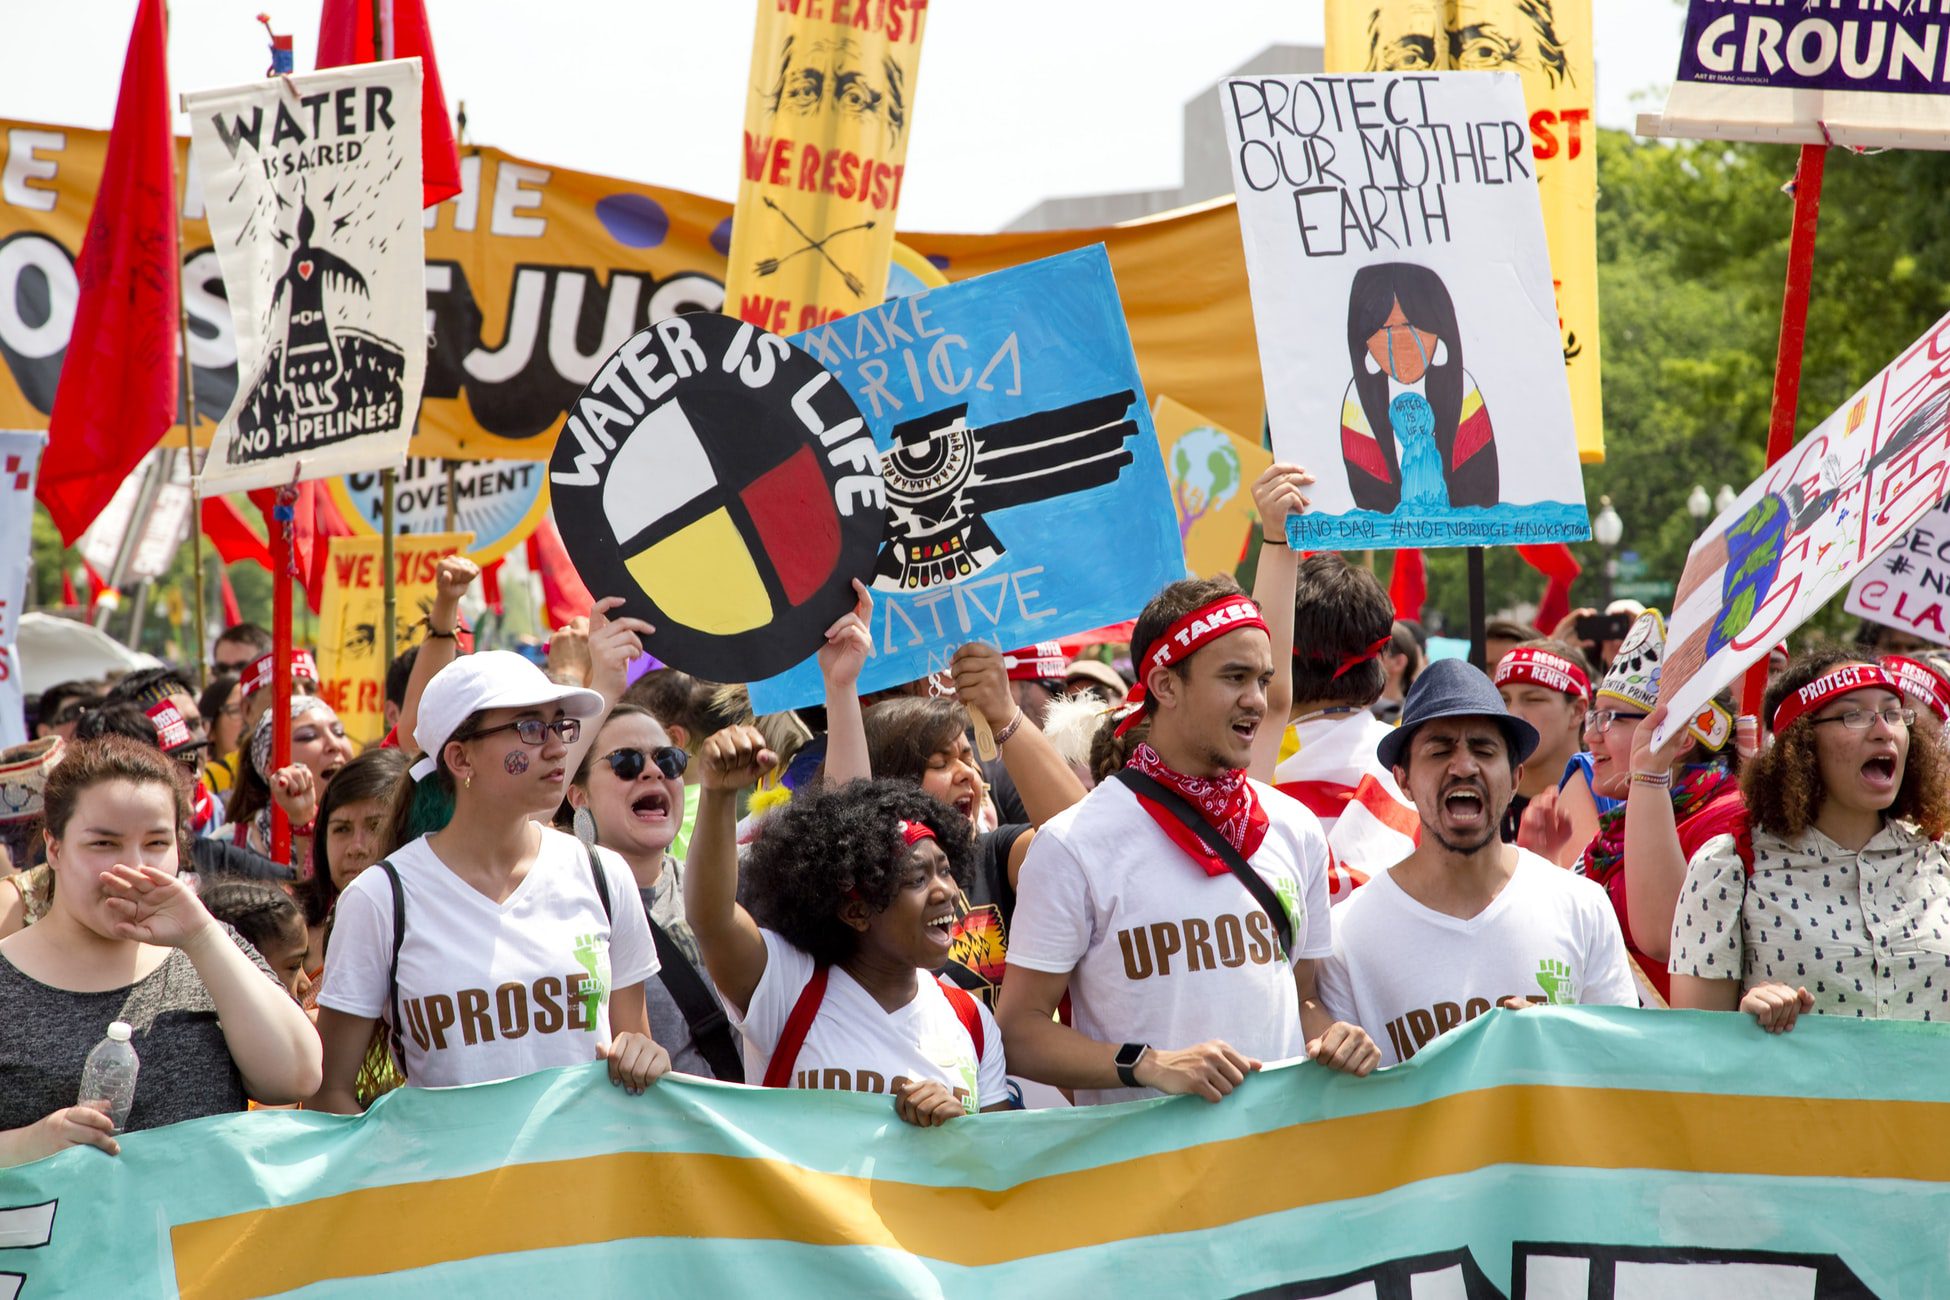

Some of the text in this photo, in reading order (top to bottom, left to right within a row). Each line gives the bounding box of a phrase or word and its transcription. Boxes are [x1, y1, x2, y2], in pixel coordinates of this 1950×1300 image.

[1697, 13, 1950, 82] GROUN
[211, 87, 396, 160] WATER
[1229, 77, 1439, 142] PROTECT
[262, 141, 363, 180] IS SACRED
[744, 130, 904, 210] WE RESIST
[1240, 121, 1530, 191] OUR MOTHER
[424, 156, 552, 238] HE
[1294, 184, 1451, 257] EARTH
[741, 294, 791, 334] WE
[803, 291, 945, 365] MAKE
[237, 401, 397, 455] NO PIPELINES!
[551, 316, 887, 517] WATER IS LIFE
[1290, 520, 1332, 541] #NO
[1337, 520, 1382, 538] DAPL
[1390, 520, 1509, 539] #NOENBRIDGE
[334, 553, 373, 589] WE
[867, 565, 1058, 660] ATIVE
[1152, 603, 1258, 666] IT TAKES
[1531, 665, 1570, 691] RENEW
[1532, 651, 1572, 673] RESIST
[1799, 667, 1862, 705] PROTECT
[1898, 677, 1935, 705] RENEW
[1901, 662, 1938, 689] RESIST
[403, 973, 594, 1051] UPROSE
